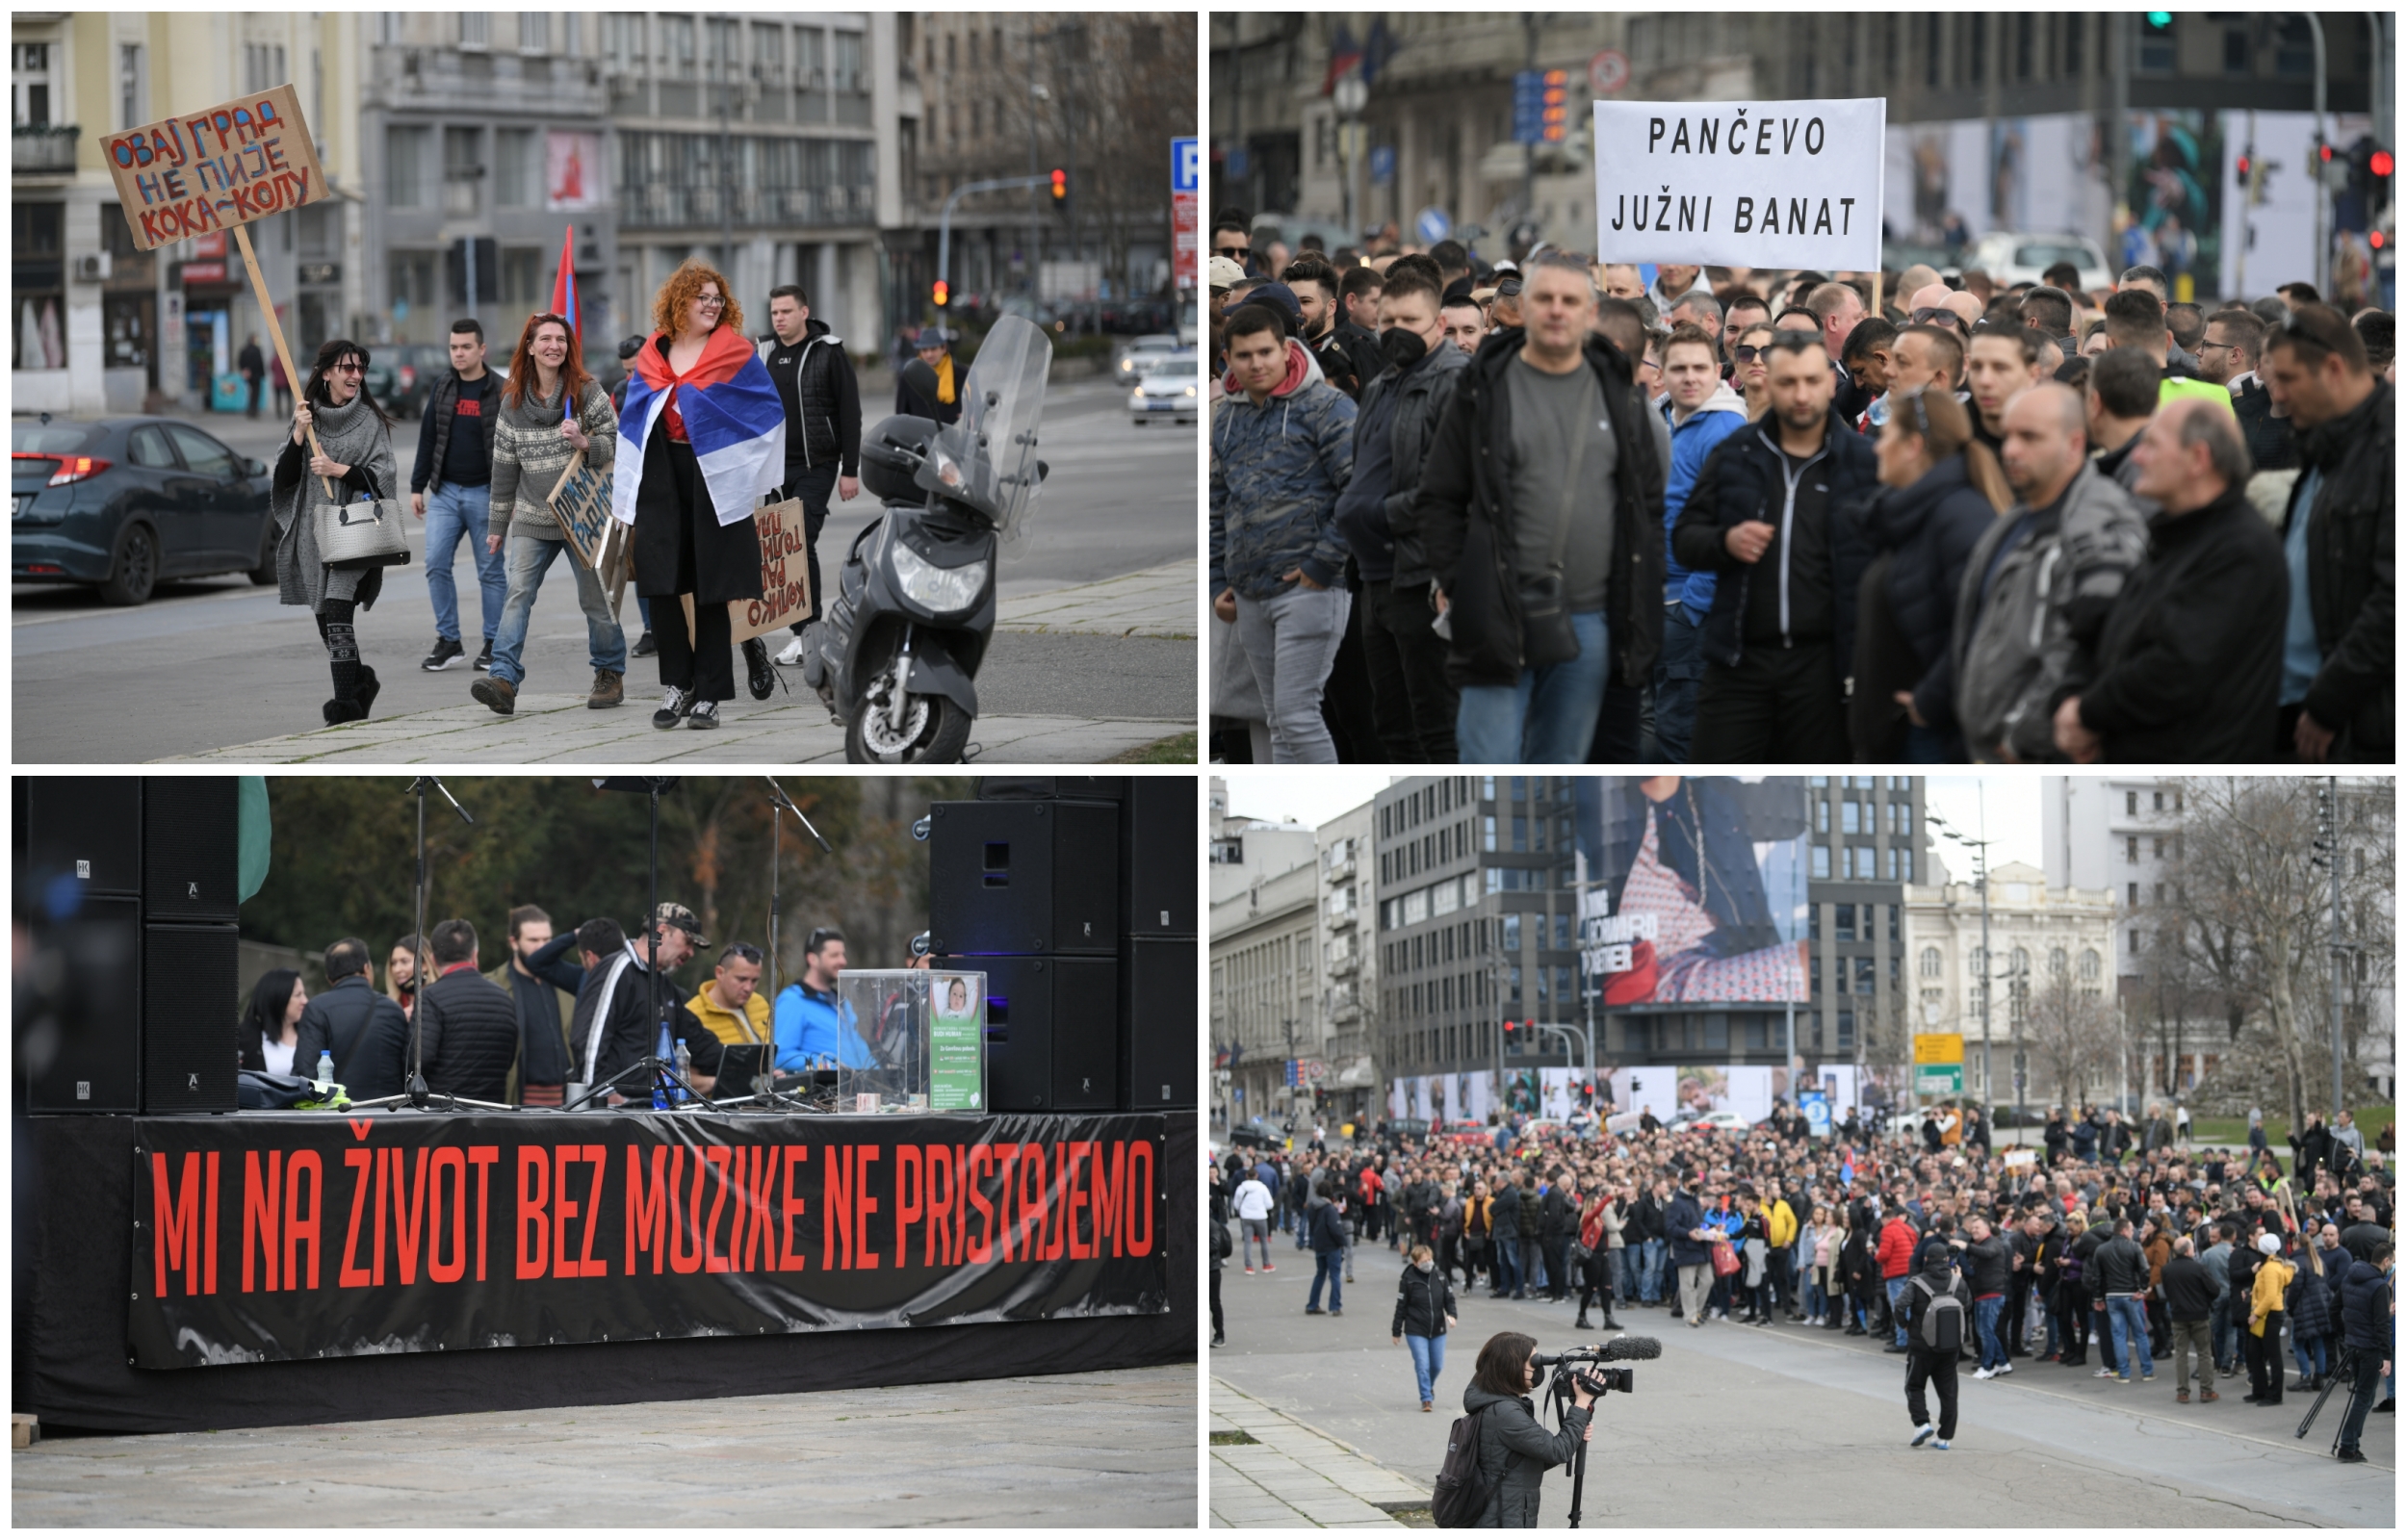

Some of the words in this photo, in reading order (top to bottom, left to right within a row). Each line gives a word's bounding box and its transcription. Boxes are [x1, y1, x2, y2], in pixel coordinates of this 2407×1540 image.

[111, 116, 189, 168] ОВАЈ
[186, 100, 285, 158] ГРАД
[1648, 108, 1825, 156] PANČEVO
[135, 168, 189, 205] НЕ
[194, 136, 291, 192] ПИЈЕ
[1611, 185, 1712, 232] JUŽNI
[1734, 196, 1855, 236] BANAT
[760, 525, 802, 563] ТОЛИ
[747, 576, 806, 627] КОЛИКО
[152, 1151, 220, 1297] MI
[242, 1149, 323, 1293] NA
[339, 1118, 499, 1288] ŽIVOT
[516, 1144, 608, 1280] BEZ
[625, 1144, 808, 1276] MUZIKE
[822, 1143, 880, 1270] NE
[895, 1140, 1153, 1269] PRISTAJEMO
